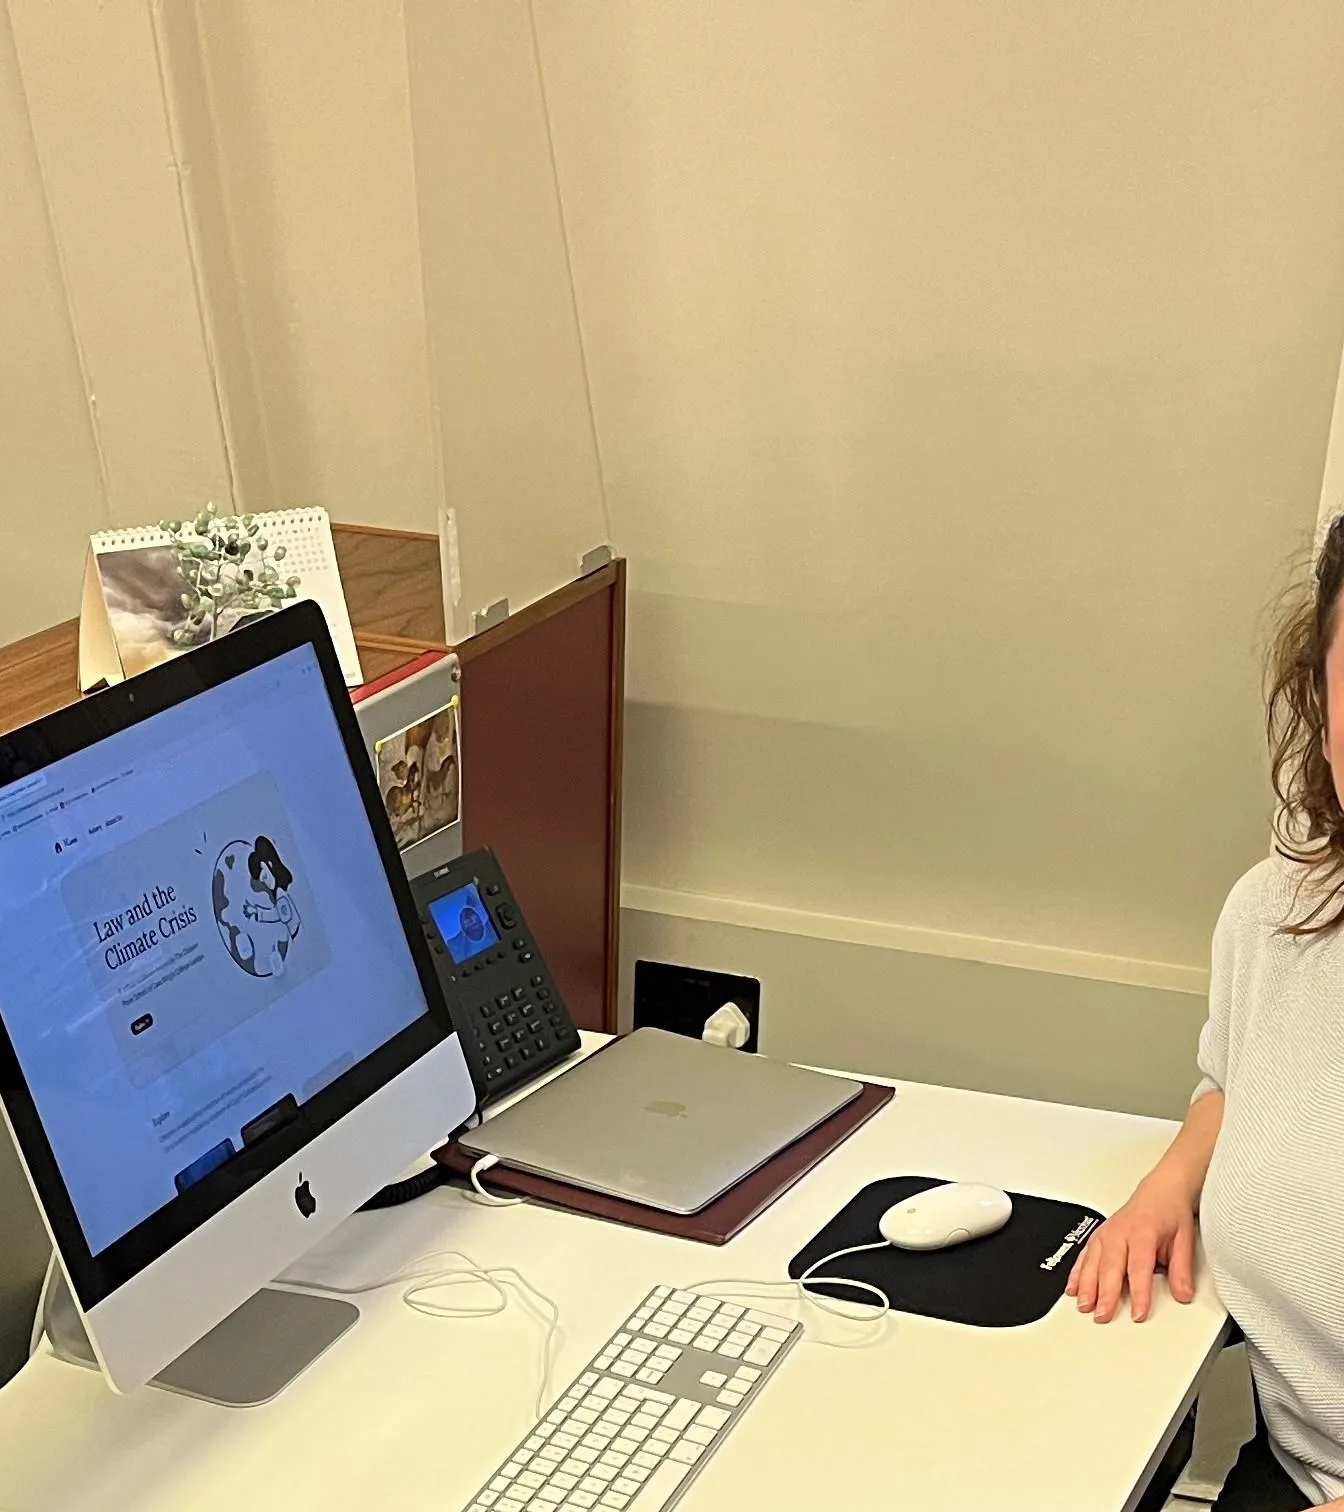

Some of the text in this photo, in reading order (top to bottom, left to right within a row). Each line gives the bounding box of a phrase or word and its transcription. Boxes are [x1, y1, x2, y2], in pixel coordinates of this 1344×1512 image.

[93, 885, 177, 944] Law and the
[104, 929, 159, 970] Climate
[158, 904, 198, 939] Crisis
